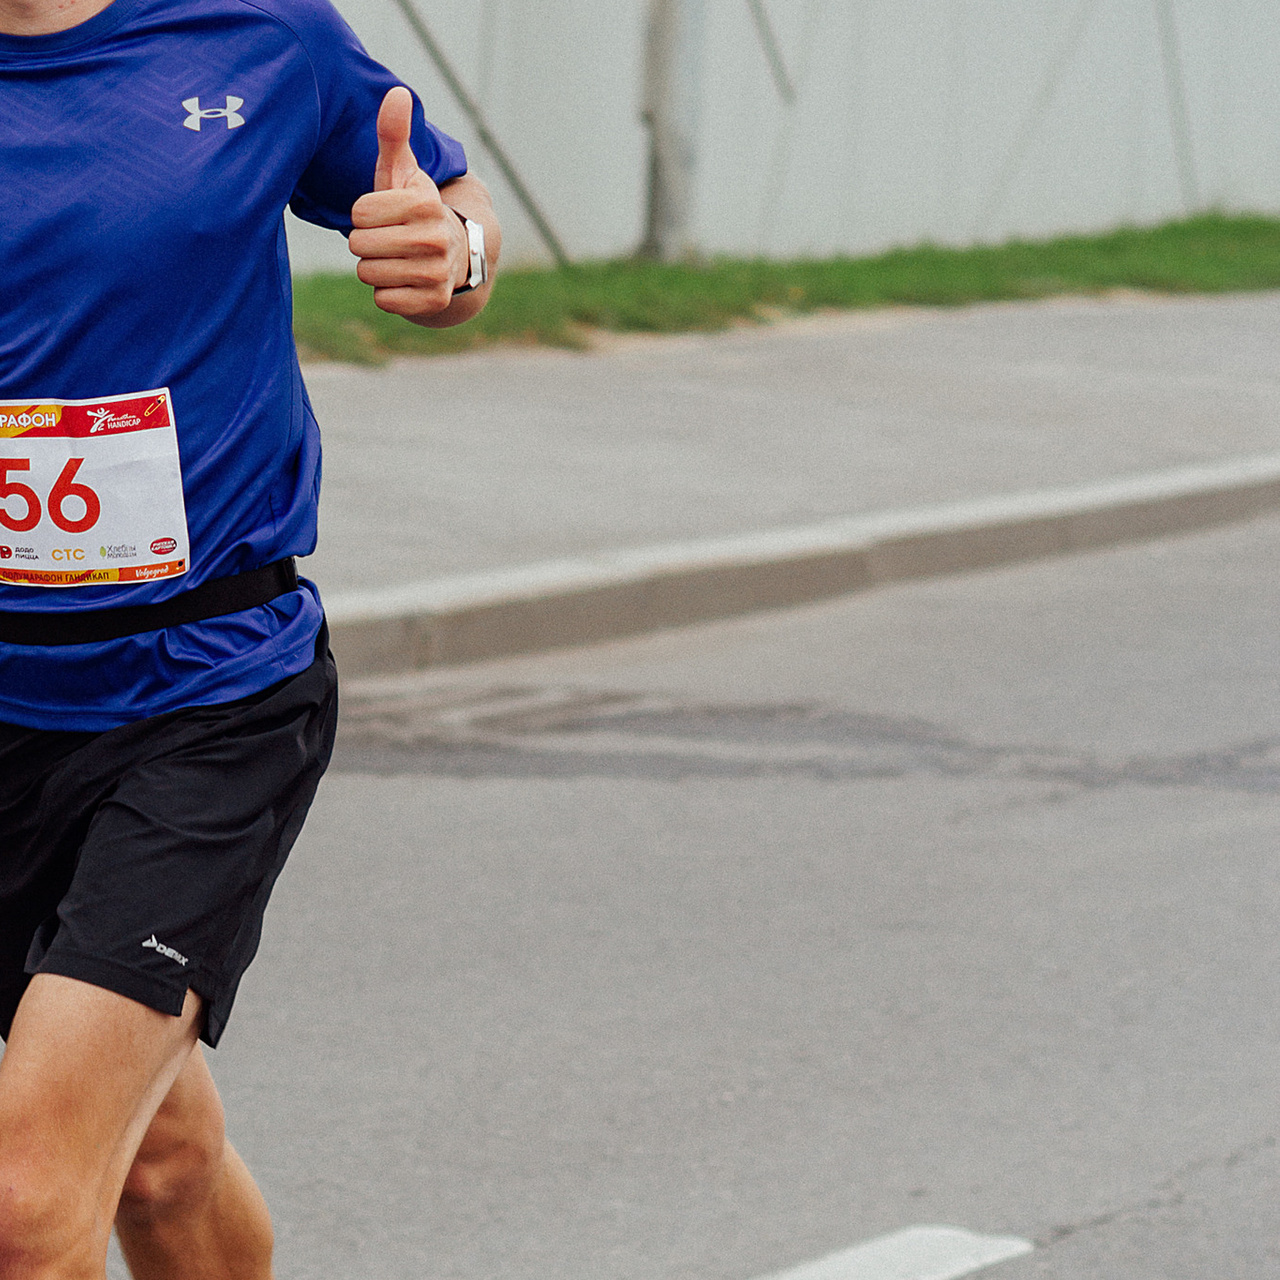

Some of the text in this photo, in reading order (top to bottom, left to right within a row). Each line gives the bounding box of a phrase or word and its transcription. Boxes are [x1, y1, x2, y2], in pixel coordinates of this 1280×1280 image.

[107, 418, 141, 429] HANDICAP
[52, 548, 86, 562] СТС
[2, 571, 109, 582] ПОЛУМАРАФОН ГАНДИКАП
[135, 565, 169, 579] Volgograd
